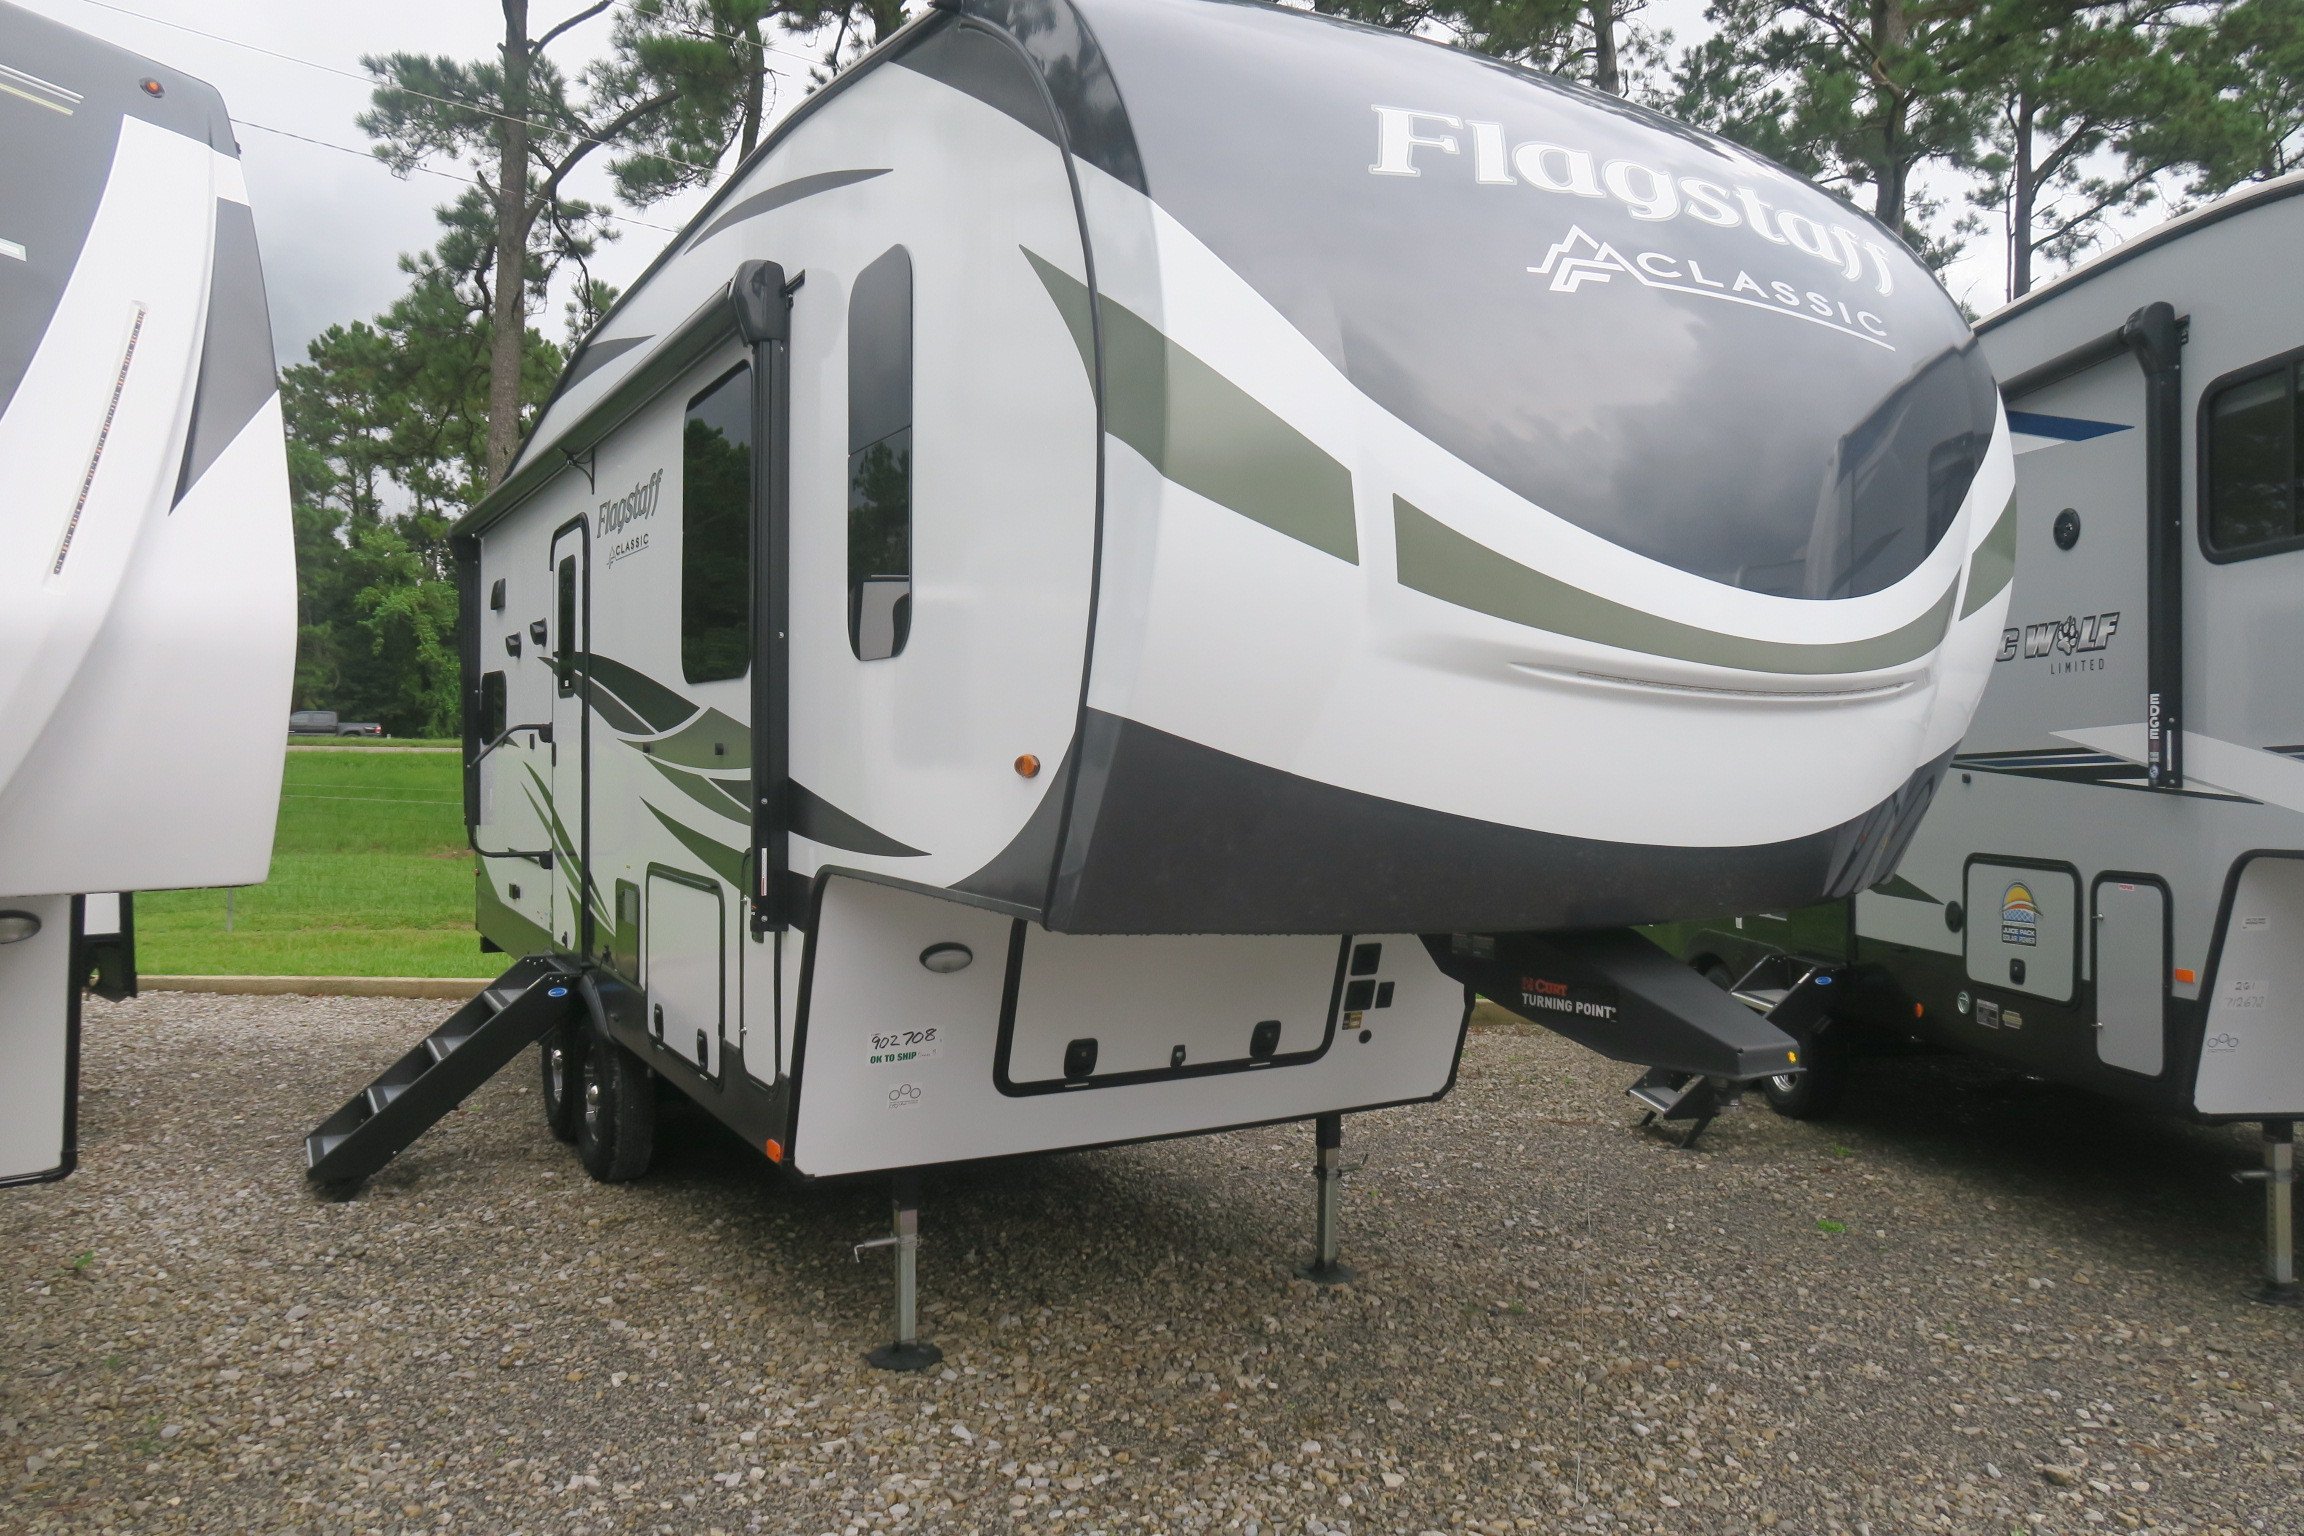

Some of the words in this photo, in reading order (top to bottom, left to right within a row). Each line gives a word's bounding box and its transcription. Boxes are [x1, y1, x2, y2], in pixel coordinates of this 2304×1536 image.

[1368, 104, 1895, 297] Flagstaff
[1636, 251, 1889, 337] CLASSIC
[597, 467, 664, 539] Flagstaff
[615, 533, 649, 556] CLASSIC
[2050, 658, 2105, 675] LIMITED
[2149, 693, 2160, 740] EDGE
[1522, 993, 1573, 1012] TURNING
[870, 1055, 882, 1064] OK
[885, 1053, 895, 1063] TO
[897, 1051, 917, 1062] SHIP
